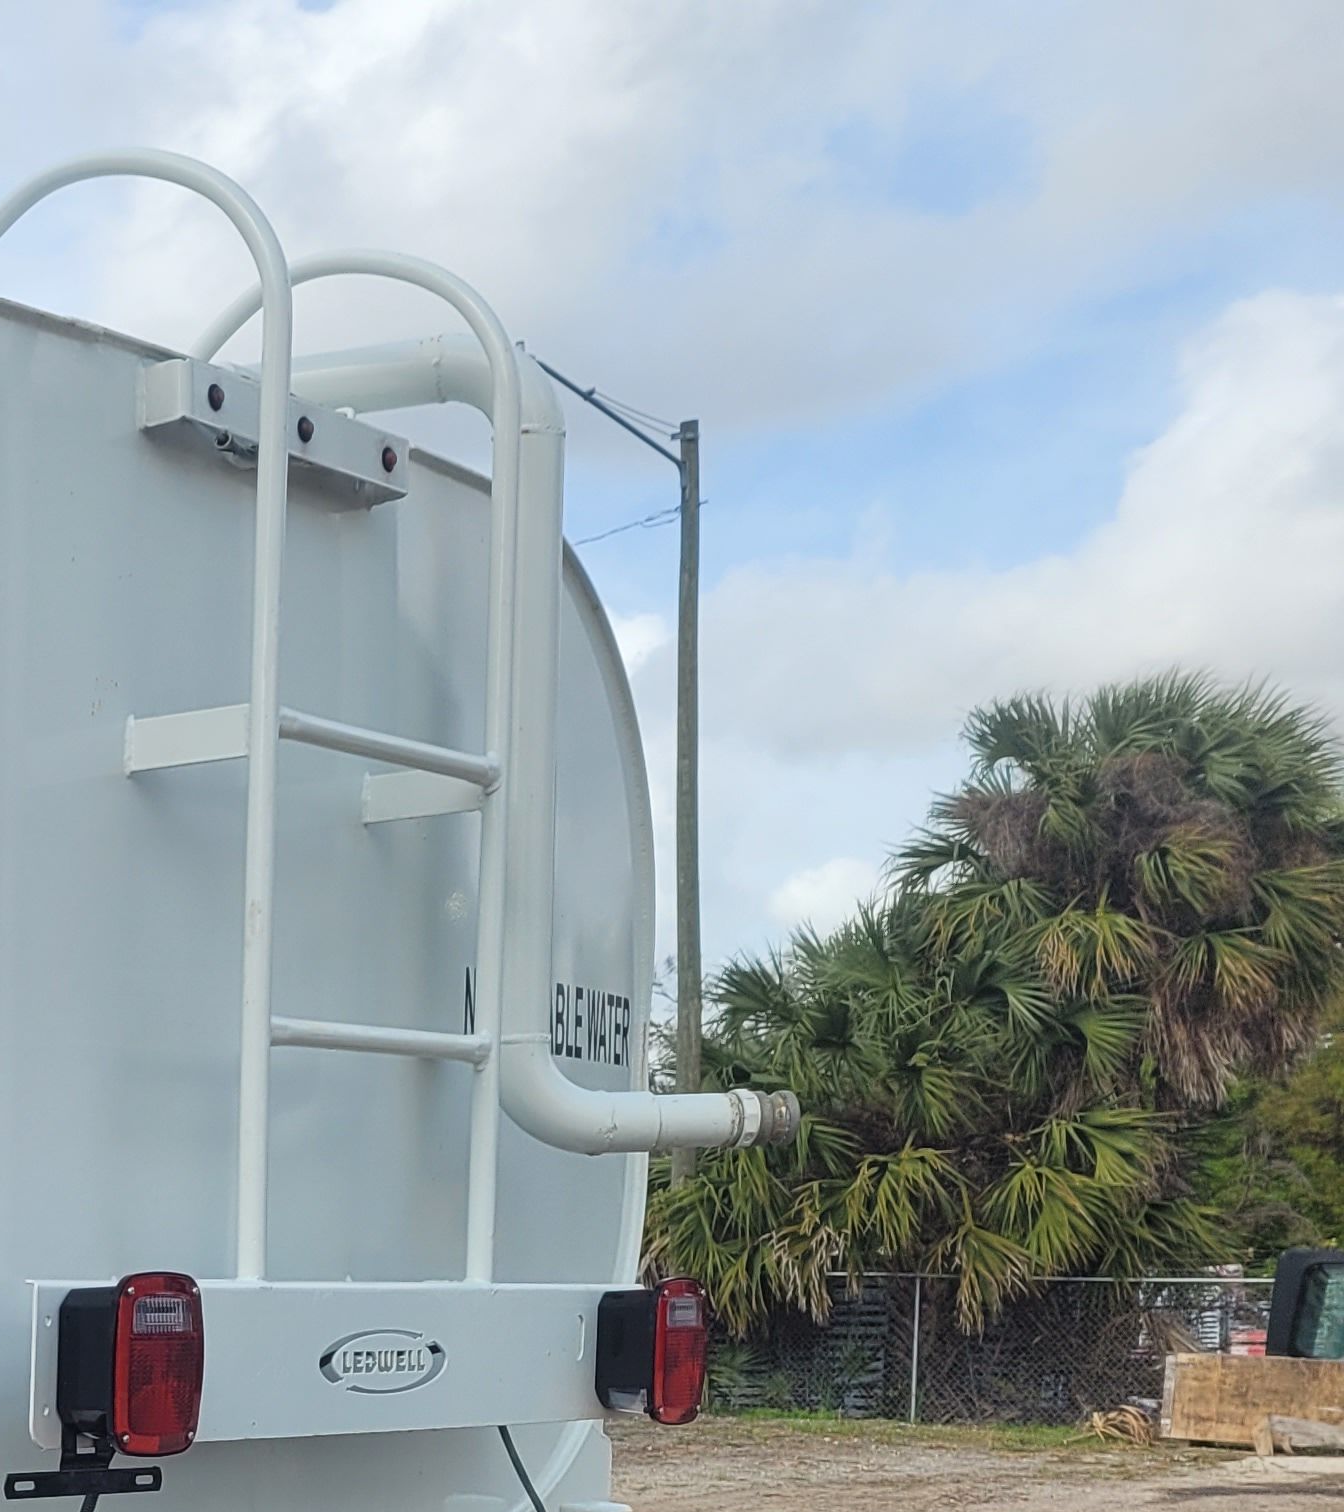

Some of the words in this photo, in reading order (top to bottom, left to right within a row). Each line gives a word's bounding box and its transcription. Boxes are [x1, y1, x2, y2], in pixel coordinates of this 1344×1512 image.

[550, 982, 584, 1060] BLE
[587, 988, 630, 1068] WATER
[342, 1349, 425, 1374] LEDWELL
